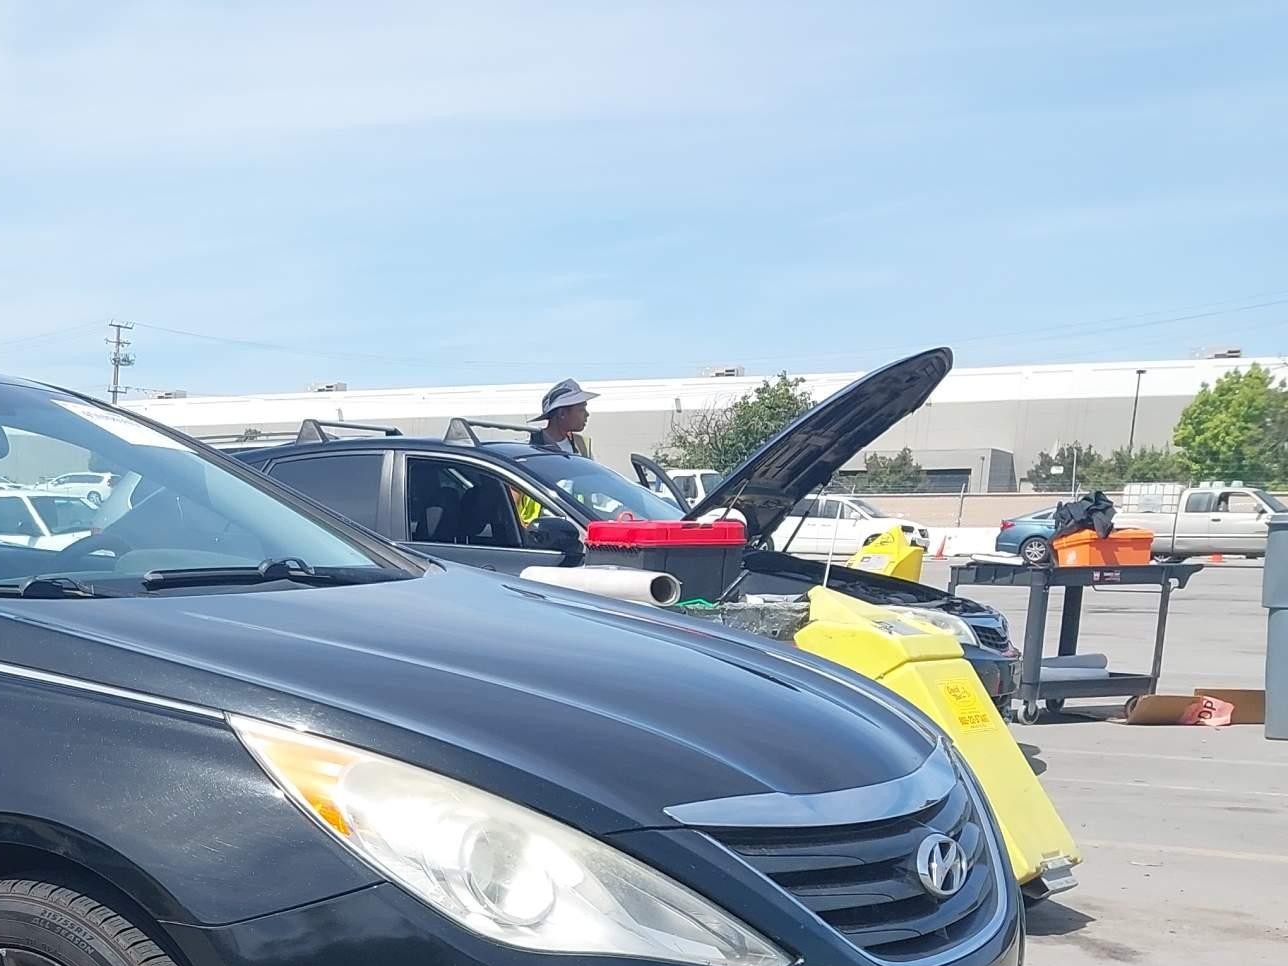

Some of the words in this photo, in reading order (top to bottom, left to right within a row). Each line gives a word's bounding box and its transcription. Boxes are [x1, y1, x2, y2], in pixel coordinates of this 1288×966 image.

[31, 917, 52, 929] ALL
[54, 926, 95, 955] SEASON
[40, 909, 95, 941] 215/55R17
